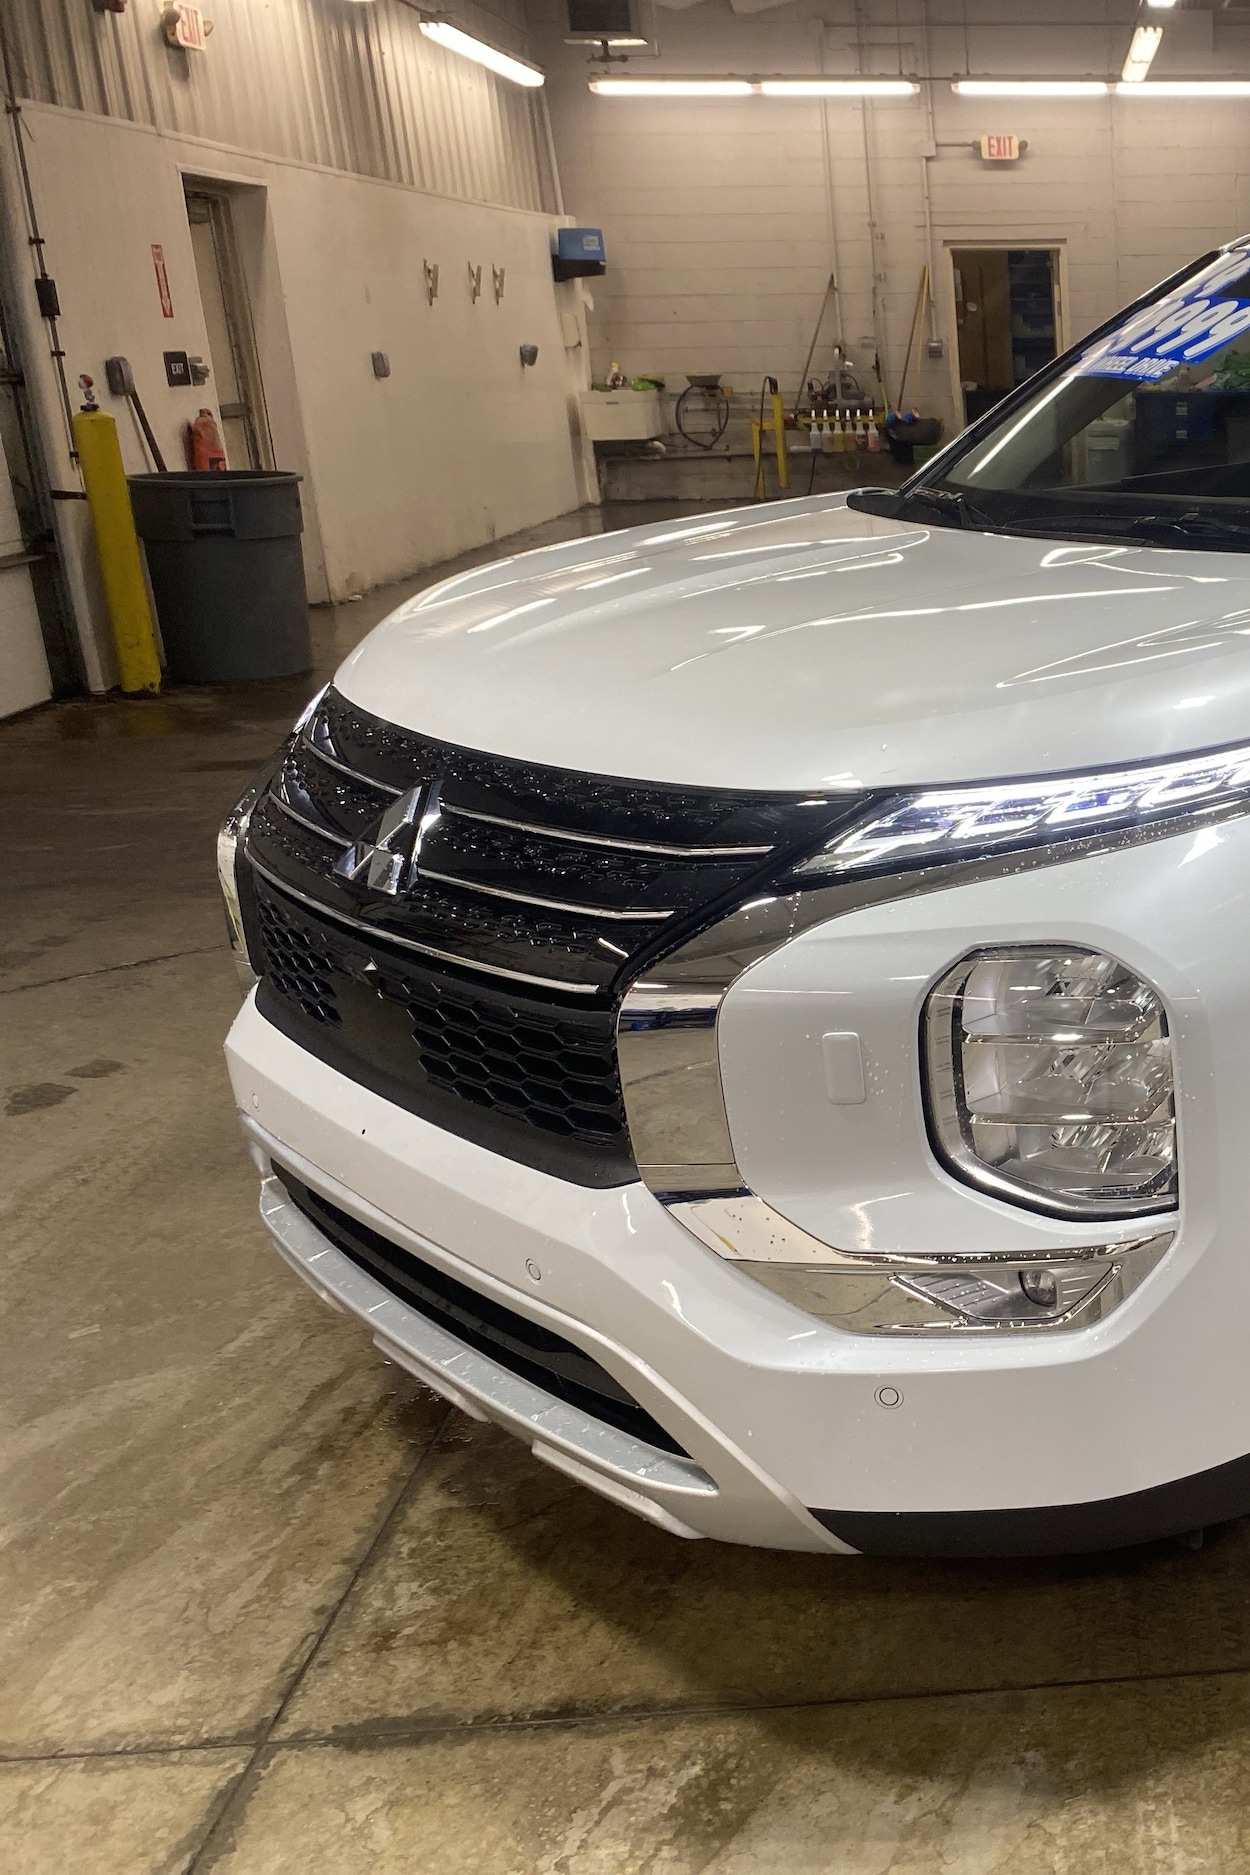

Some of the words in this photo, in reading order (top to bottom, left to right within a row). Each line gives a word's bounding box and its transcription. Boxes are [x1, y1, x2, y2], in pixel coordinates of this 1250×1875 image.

[178, 3, 202, 47] EXIT
[987, 135, 1013, 158] EXIT
[1124, 357, 1180, 378] DRIVE
